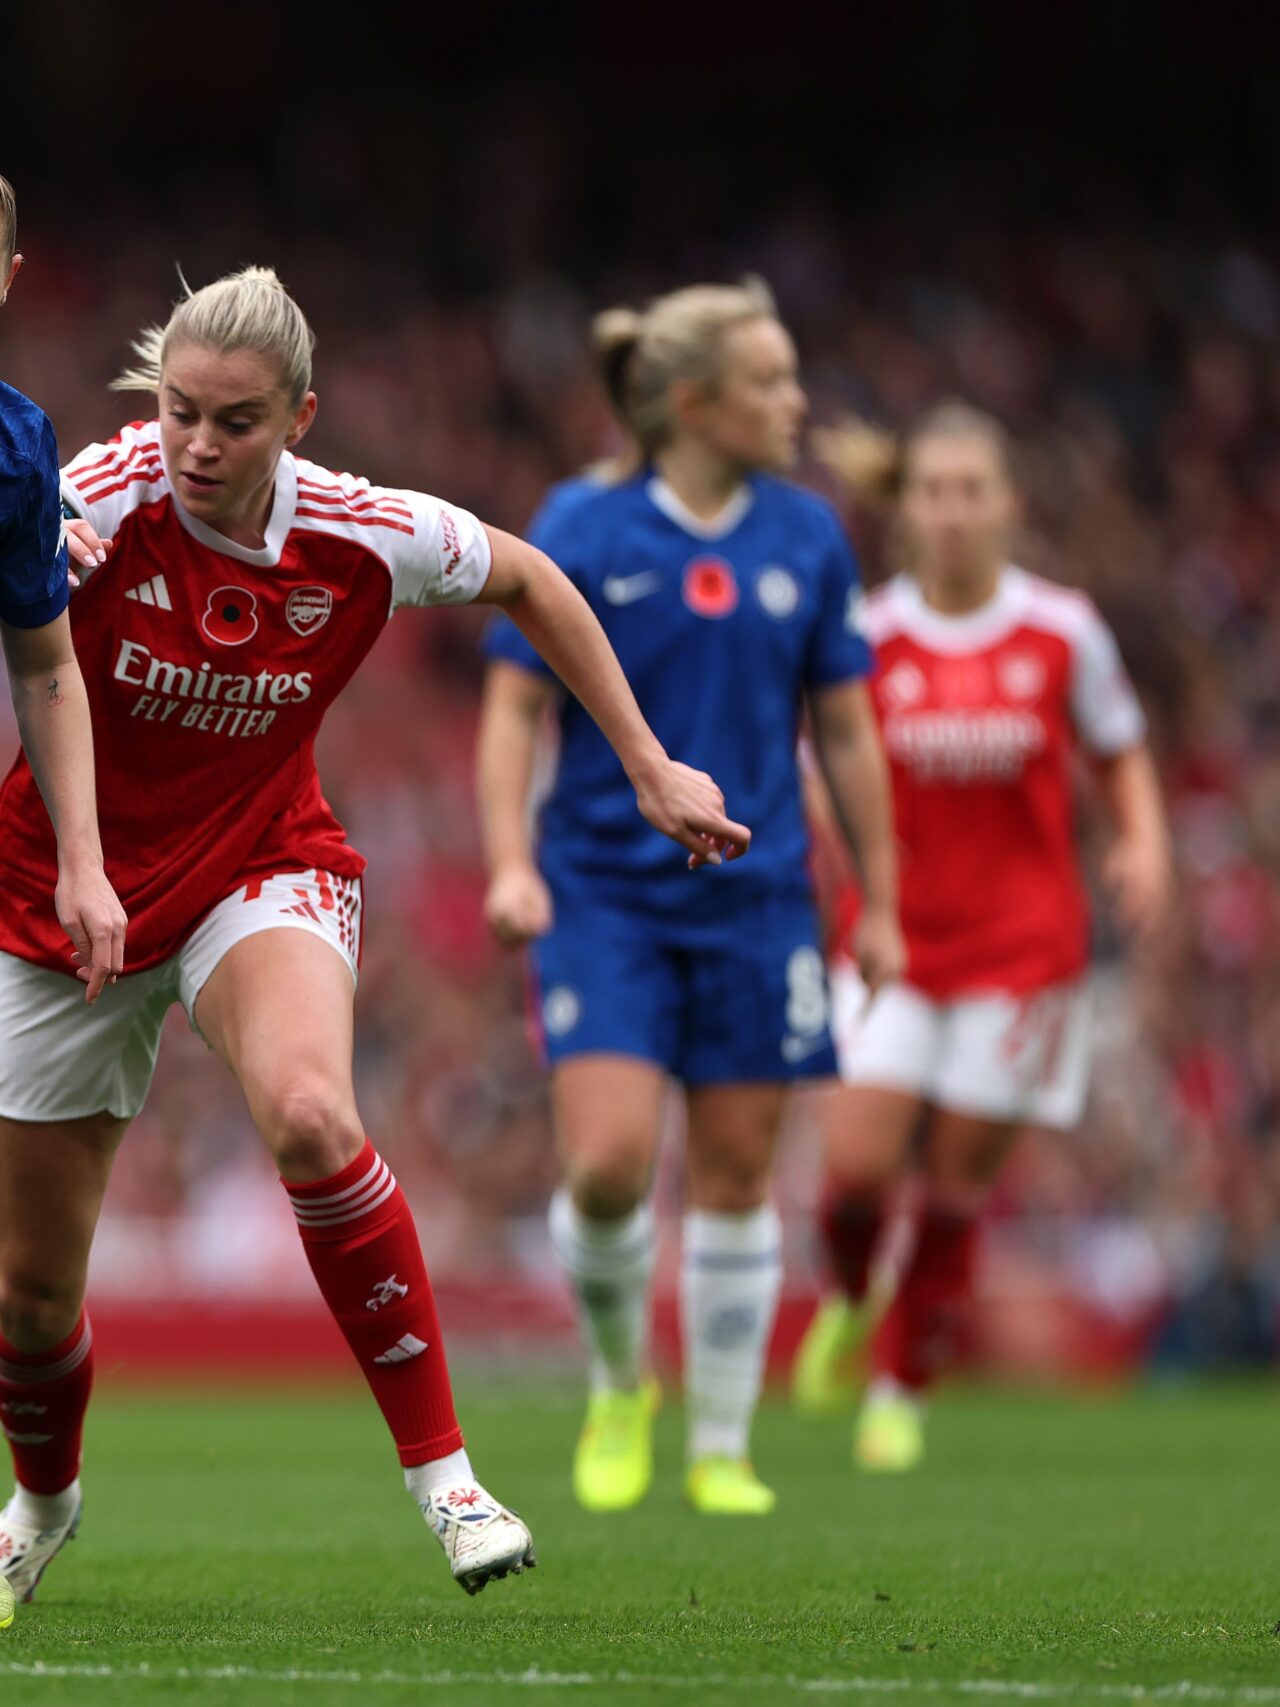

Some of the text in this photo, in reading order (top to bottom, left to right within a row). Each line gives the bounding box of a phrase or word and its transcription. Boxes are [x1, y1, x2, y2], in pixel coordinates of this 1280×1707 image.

[114, 638, 312, 704] Emirates
[130, 694, 277, 738] FLY BETTER
